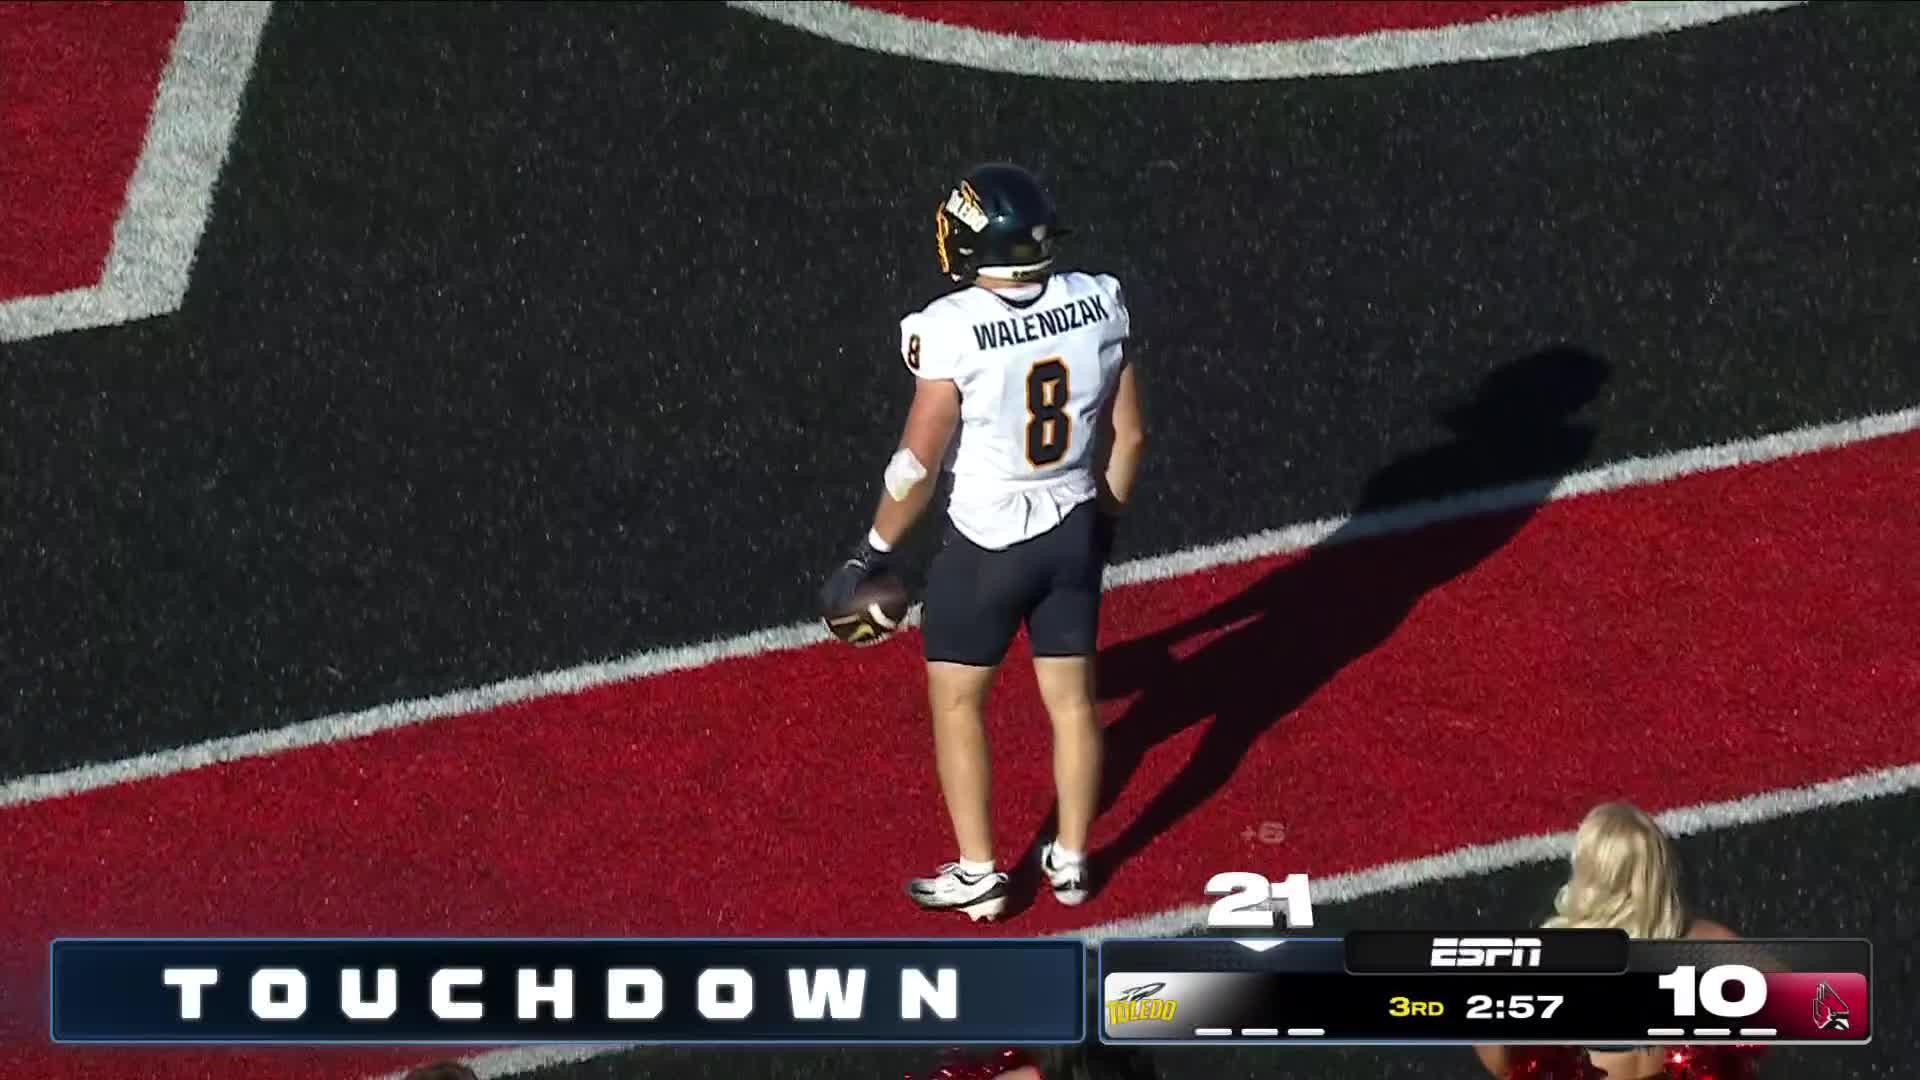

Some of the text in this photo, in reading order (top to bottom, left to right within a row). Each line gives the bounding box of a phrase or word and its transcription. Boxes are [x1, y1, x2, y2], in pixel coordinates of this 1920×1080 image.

[973, 295, 1109, 351] WALENDZAK
[907, 334, 921, 369] 8
[1026, 357, 1072, 468] 8
